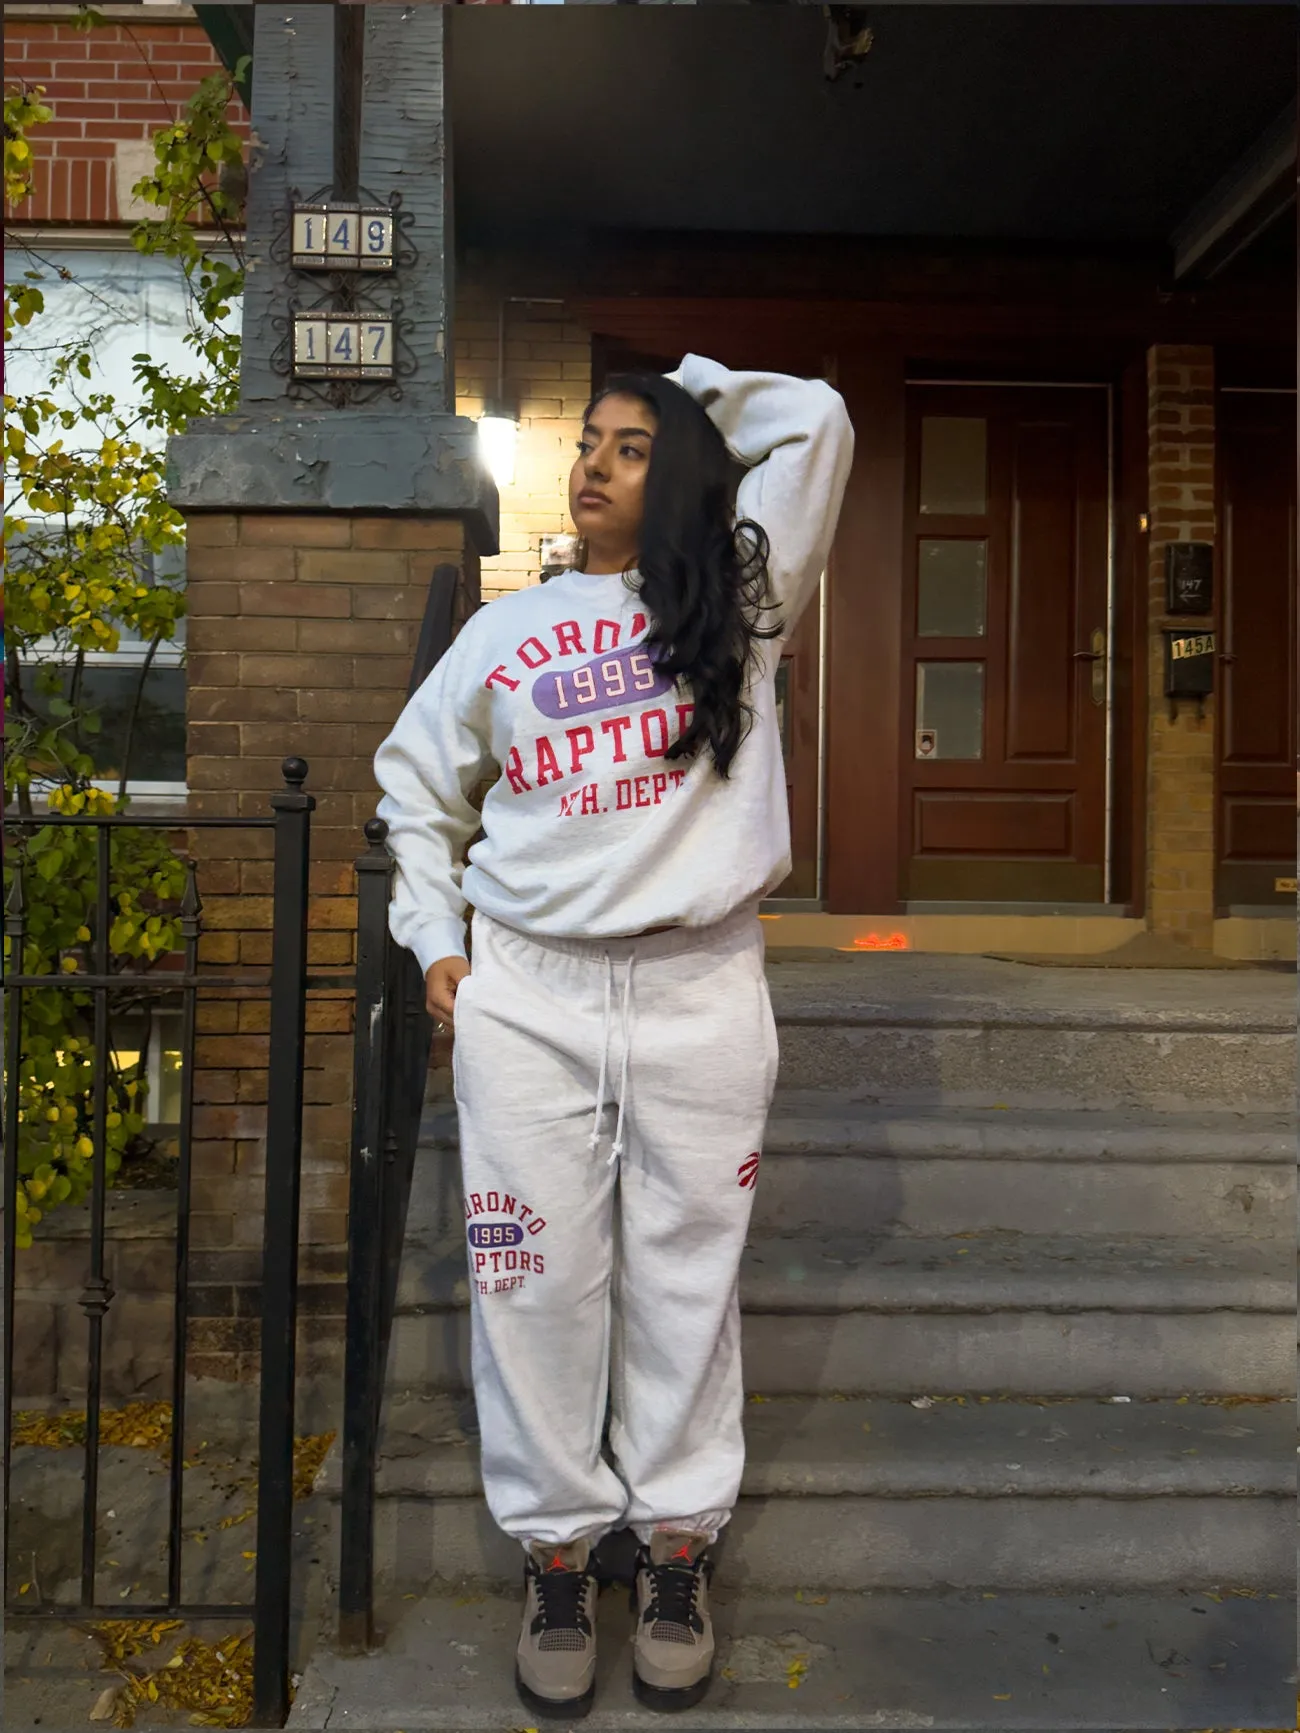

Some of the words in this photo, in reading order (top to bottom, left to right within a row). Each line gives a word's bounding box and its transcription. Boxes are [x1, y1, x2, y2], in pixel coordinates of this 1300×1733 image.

[304, 217, 385, 253] 149
[305, 326, 386, 361] 147
[1181, 579, 1202, 591] 147
[1175, 635, 1214, 657] 145A
[554, 654, 656, 709] 1995
[474, 1226, 515, 1244] 1995
[470, 1250, 545, 1274] PTORS
